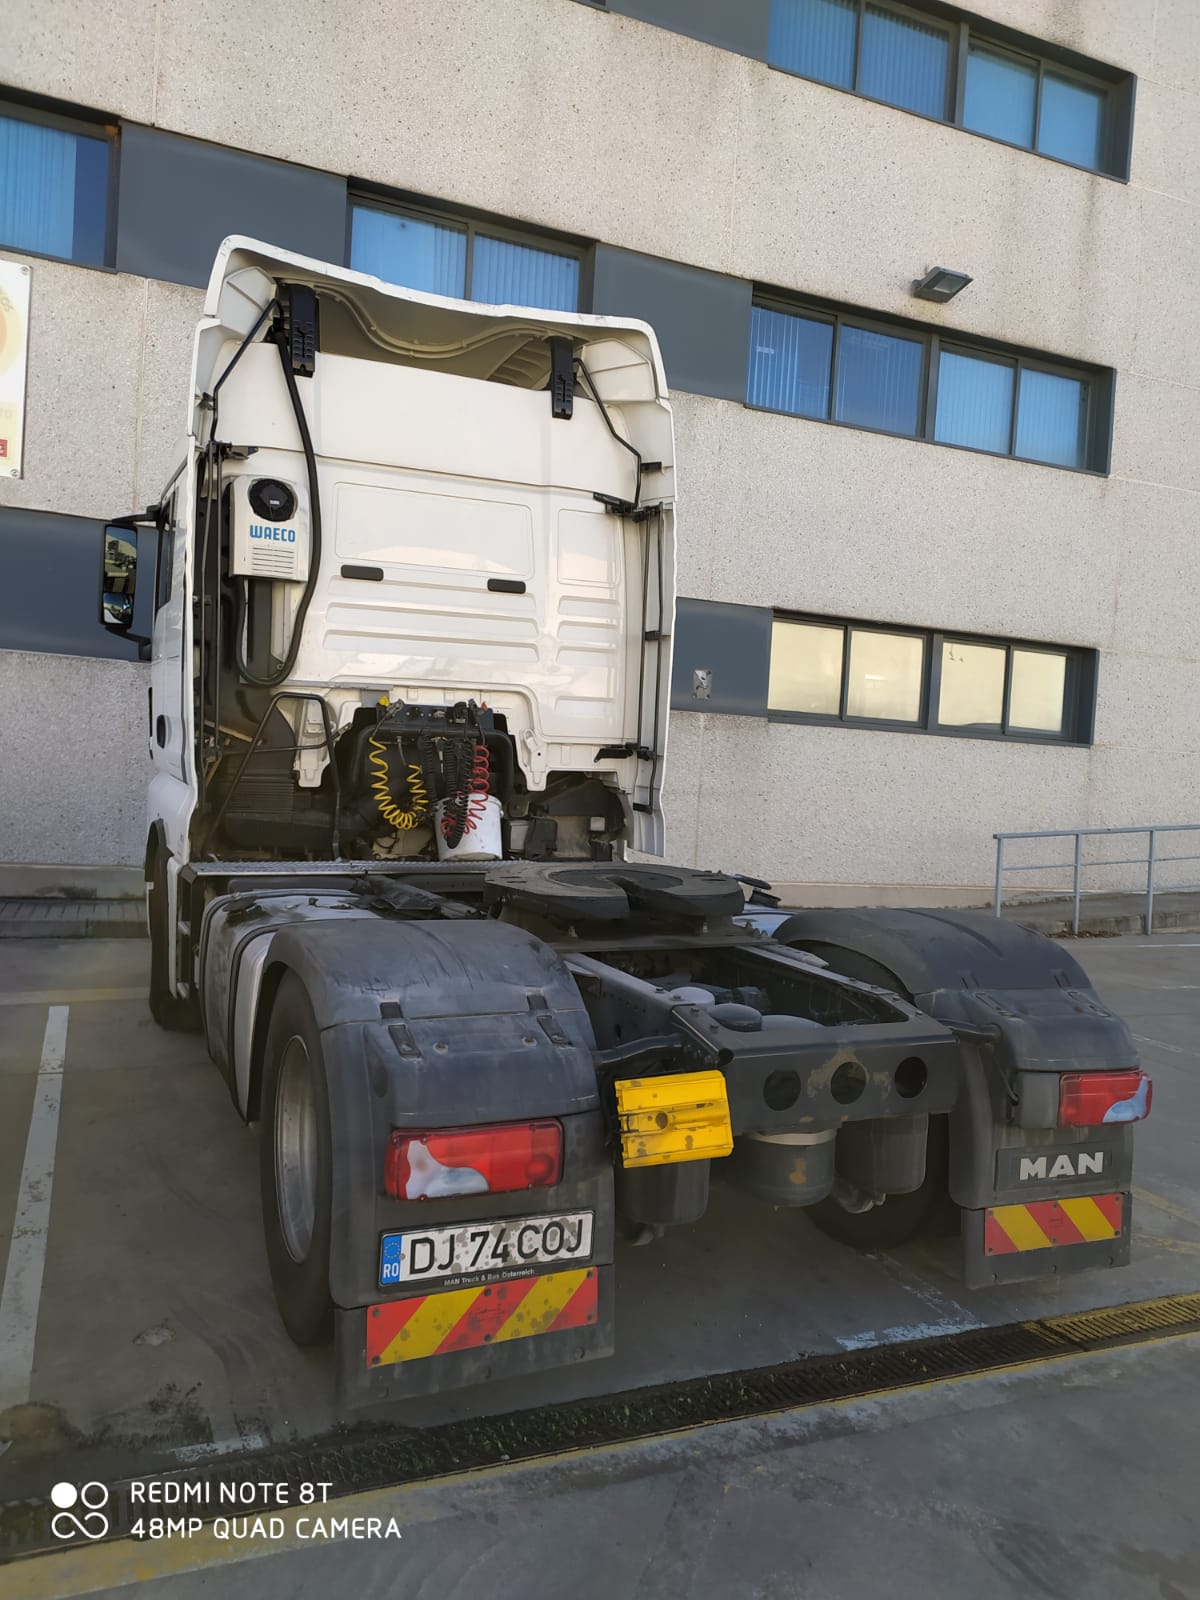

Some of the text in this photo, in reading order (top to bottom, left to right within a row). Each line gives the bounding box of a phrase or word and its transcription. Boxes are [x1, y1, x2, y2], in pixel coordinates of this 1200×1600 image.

[249, 525, 296, 543] WAECO
[1019, 1152, 1104, 1181] MAN
[409, 1219, 584, 1275] DJ 74 COJ
[383, 1262, 399, 1279] RO
[444, 1277, 460, 1286] MAN
[462, 1275, 479, 1284] Truck
